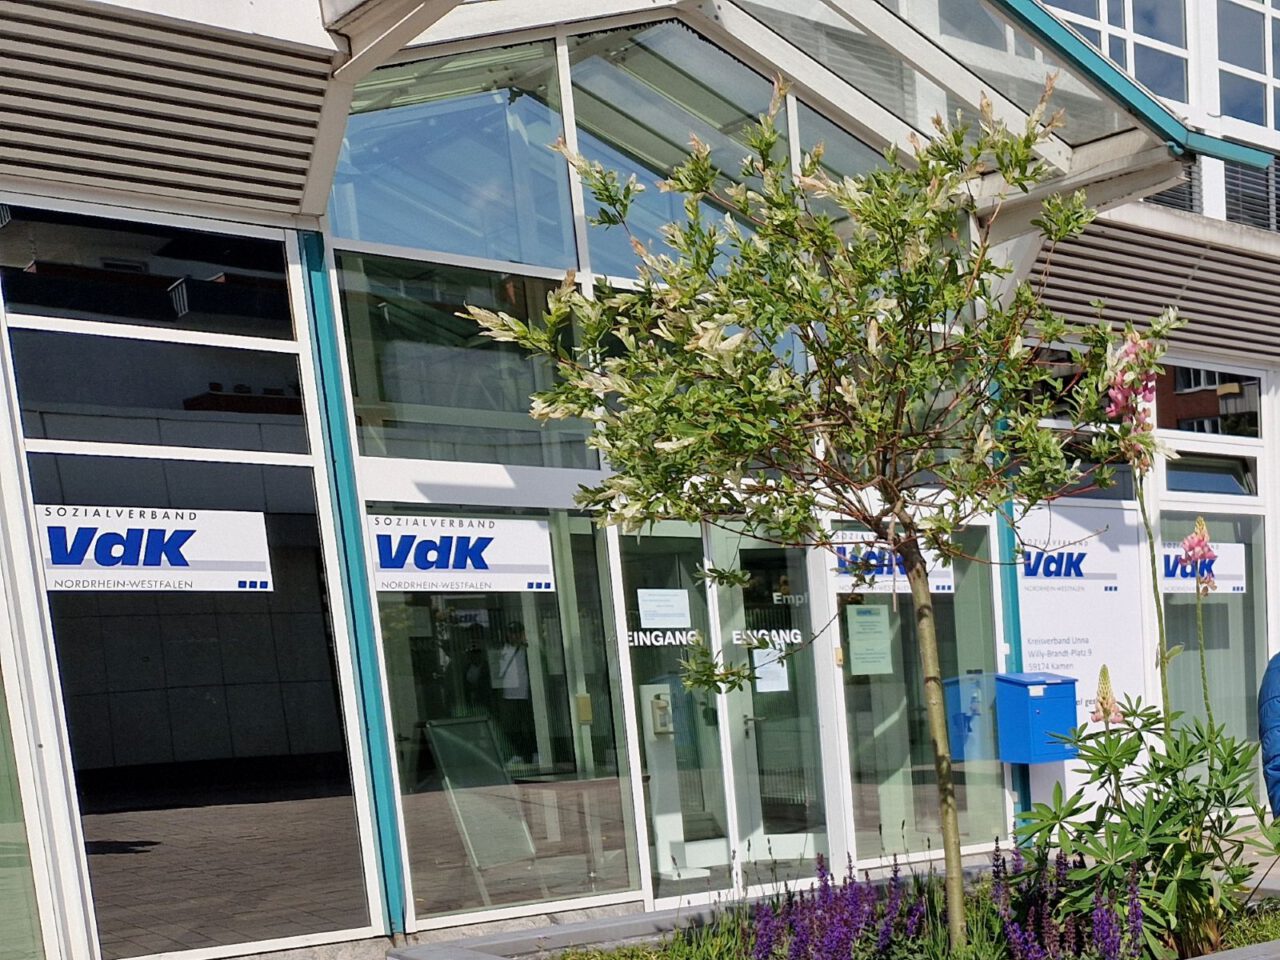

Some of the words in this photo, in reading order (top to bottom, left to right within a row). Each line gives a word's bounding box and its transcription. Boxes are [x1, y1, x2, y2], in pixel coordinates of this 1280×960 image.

[45, 507, 197, 520] SOZIALVERBAND
[375, 517, 495, 528] SOZIALVERBAND
[47, 526, 197, 567] VdK
[376, 534, 494, 570] VdK
[1024, 551, 1087, 577] VdK
[1164, 554, 1216, 578] VdK
[54, 579, 193, 589] NORDRHEIN-WESTFALEN
[382, 580, 492, 590] NORDRHEIN-WESTFALEN
